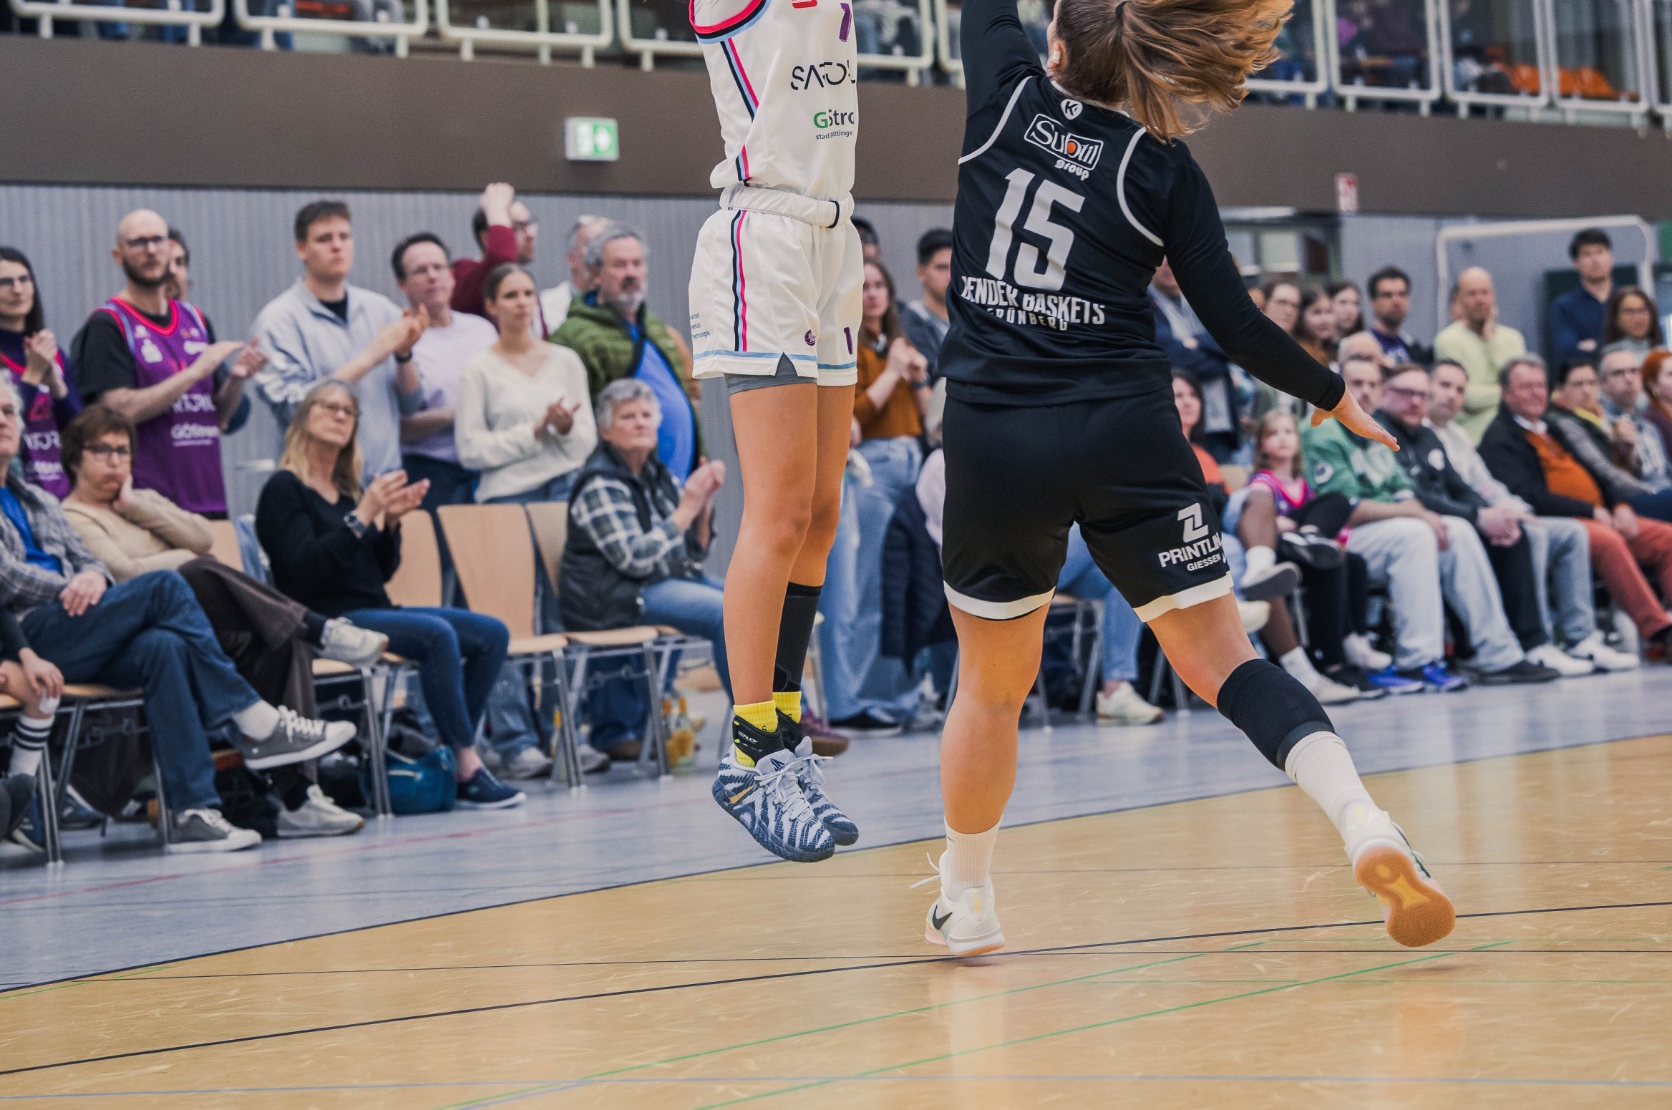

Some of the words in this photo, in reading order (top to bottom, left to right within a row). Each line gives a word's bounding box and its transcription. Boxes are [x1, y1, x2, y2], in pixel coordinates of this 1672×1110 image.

[1030, 120, 1099, 165] Subtil
[1054, 159, 1090, 181] group
[985, 167, 1086, 292] 15
[1022, 293, 1105, 325] BASKETS
